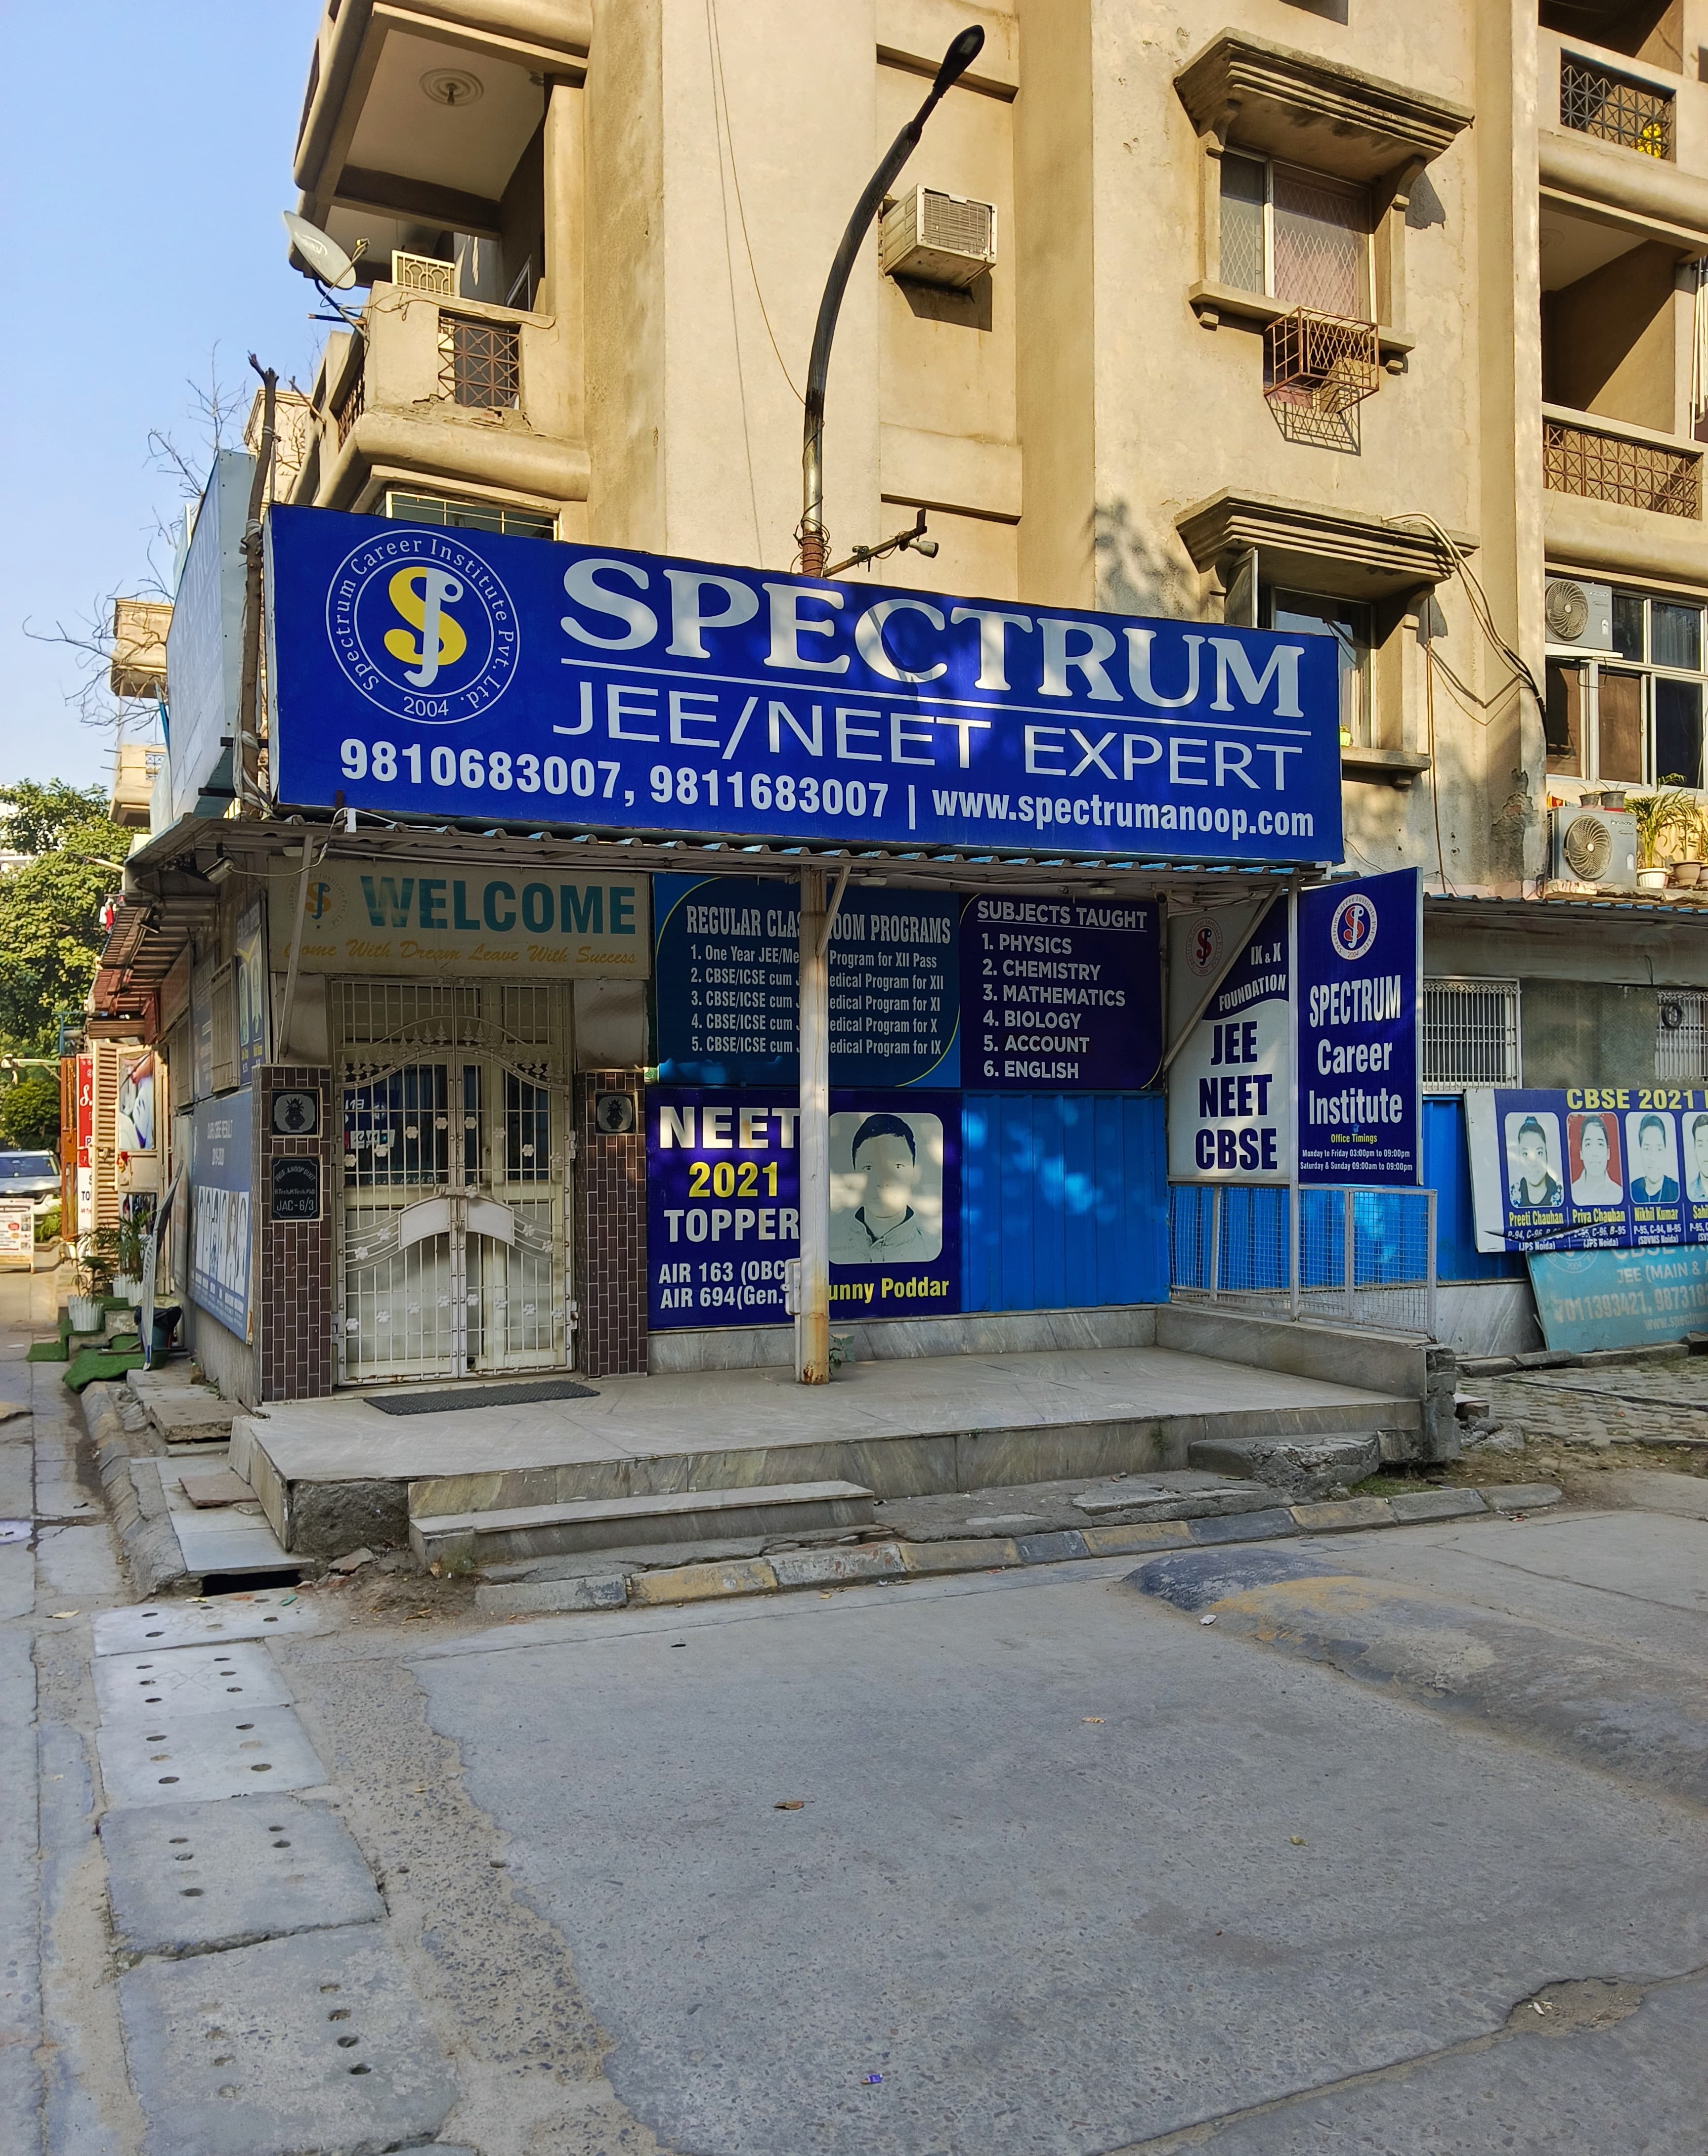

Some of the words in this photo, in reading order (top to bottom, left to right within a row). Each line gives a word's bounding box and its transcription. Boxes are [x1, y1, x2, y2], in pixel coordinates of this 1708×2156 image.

[351, 539, 422, 577] Career
[430, 538, 508, 621] Institute
[336, 577, 380, 691] Spectrum
[560, 558, 1305, 718] SPECTRUM
[492, 630, 515, 672] Pvt.
[460, 676, 501, 710] Ltd.
[403, 697, 449, 717] 2004
[553, 681, 991, 769] JEE/NEET
[1025, 724, 1303, 791] EXPERT
[340, 738, 635, 807] 9810683007,
[650, 764, 889, 818] 9811683007
[932, 789, 1314, 841] www.spectrumanoop.com
[359, 875, 636, 935] WELCOME
[977, 900, 1071, 925] SUBJECTS
[1076, 907, 1147, 929] TAUGHT
[1337, 897, 1355, 915] Career
[1356, 895, 1375, 918] Institute
[687, 906, 762, 936] REGULAR
[871, 915, 951, 944] PROGRAMS
[346, 938, 391, 959] With
[400, 940, 461, 961] Dream
[468, 943, 520, 962] Leave
[527, 945, 568, 964] With
[575, 946, 637, 965] Success
[982, 933, 994, 950] 1.
[999, 933, 1072, 955] PHYSICS
[1250, 946, 1263, 966] IX
[1265, 953, 1271, 964] &
[1273, 942, 1281, 962] X
[691, 945, 702, 960] 1.
[705, 944, 727, 961] One
[730, 946, 755, 962] Year
[830, 950, 874, 969] Program
[878, 952, 893, 966] for
[896, 952, 909, 967] XII
[913, 953, 938, 968] Pass
[691, 968, 702, 983] 2.
[706, 968, 766, 986] CBSE/ICSE
[770, 972, 792, 986] cum
[866, 975, 909, 991] Program
[913, 975, 927, 989] for
[930, 975, 944, 990] XII
[982, 958, 997, 975] 2.
[1002, 959, 1101, 981] CHEMISTRY
[691, 991, 702, 1006] 3.
[706, 991, 766, 1009] CBSE/ICSE
[770, 995, 792, 1009] cum
[866, 997, 909, 1014] Program
[913, 997, 927, 1012] for
[930, 997, 940, 1013] XI
[982, 984, 998, 1001] 3.
[1003, 984, 1126, 1007] MATHEMATICS
[1219, 973, 1286, 1012] FOUNDATION
[1309, 974, 1401, 1028] SPECTRUM
[691, 1014, 702, 1028] 4.
[706, 1014, 766, 1031] CBSE/ICSE
[770, 1017, 792, 1031] cum
[866, 1019, 909, 1035] Program
[913, 1018, 927, 1033] for
[930, 1019, 938, 1033] X
[983, 1009, 999, 1026] 4.
[1004, 1010, 1082, 1029] BIOLOGY
[691, 1036, 702, 1052] 5.
[706, 1036, 766, 1054] CBSE/ICSE
[770, 1041, 792, 1054] cum
[866, 1041, 909, 1057] Program
[913, 1040, 927, 1055] for
[931, 1040, 941, 1055] IX
[983, 1035, 998, 1052] 5.
[1004, 1035, 1090, 1053] ACCOUNT
[1210, 1020, 1258, 1066] JEE
[1318, 1039, 1393, 1075] Career
[983, 1060, 999, 1077] 6.
[1004, 1060, 1079, 1079] ENGLISH
[1198, 1073, 1273, 1119] NEET
[1309, 1087, 1403, 1125] Institute
[1566, 1089, 1630, 1110] CBSE
[1638, 1089, 1695, 1110] 2021
[659, 1106, 801, 1148] NEET
[1331, 1134, 1350, 1143] Office
[1352, 1134, 1378, 1144] Timings
[1195, 1127, 1278, 1171] CBSE
[1302, 1149, 1323, 1158] Monday
[1331, 1149, 1349, 1158] Friday
[1350, 1149, 1375, 1158] 03:00pm
[1384, 1149, 1410, 1159] 09:00pm
[1300, 1162, 1324, 1171] Saturday
[1330, 1162, 1351, 1171] Sunday
[1352, 1162, 1377, 1170] 09:00am
[1386, 1162, 1412, 1172] 09:00pm
[688, 1162, 777, 1198] 2021
[664, 1209, 799, 1242] TOPPER
[1509, 1210, 1531, 1226] Preeti
[1532, 1210, 1564, 1226] Chauhan
[1572, 1209, 1592, 1224] Priya
[1593, 1208, 1626, 1223] Chauhan
[1656, 1206, 1678, 1221] Kumar
[1610, 1226, 1626, 1235] B-95
[1519, 1241, 1533, 1251] (JPS
[1535, 1241, 1556, 1251] Noida)
[659, 1264, 691, 1284] AIR
[698, 1263, 734, 1282] 163
[1617, 1267, 1643, 1284] JEE
[1645, 1262, 1689, 1283] (MAIN
[1692, 1261, 1701, 1276] &
[660, 1288, 692, 1309] AIR
[828, 1283, 874, 1304] unny
[881, 1276, 949, 1299] Poddar
